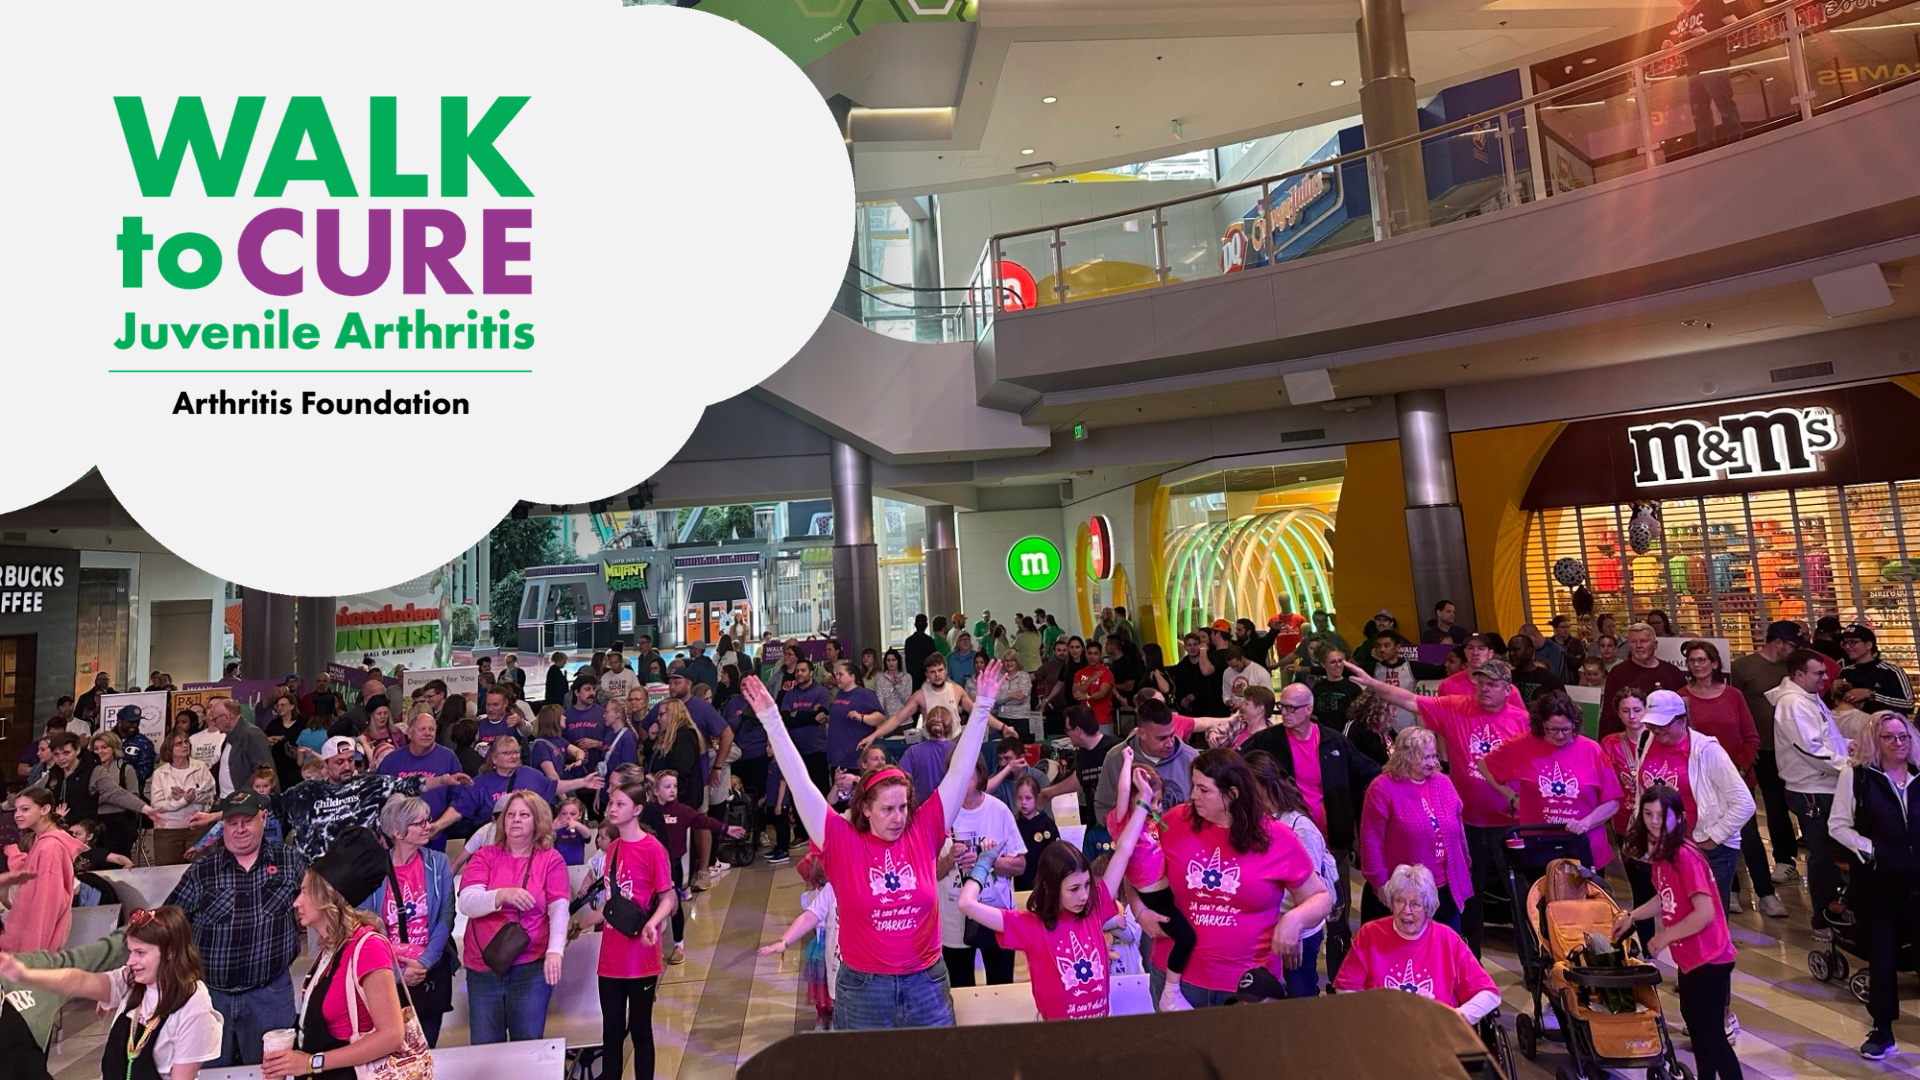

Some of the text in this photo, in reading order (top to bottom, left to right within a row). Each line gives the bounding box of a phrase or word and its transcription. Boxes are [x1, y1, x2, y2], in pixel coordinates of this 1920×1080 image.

[1020, 552, 1049, 576] m
[0, 565, 64, 587] BUCKS
[604, 560, 648, 582] MUTANT
[446, 675, 458, 683] for
[460, 674, 475, 682] You
[897, 906, 911, 915] dull
[876, 918, 914, 931] SPARKLE
[1194, 914, 1234, 926] SPARKLE
